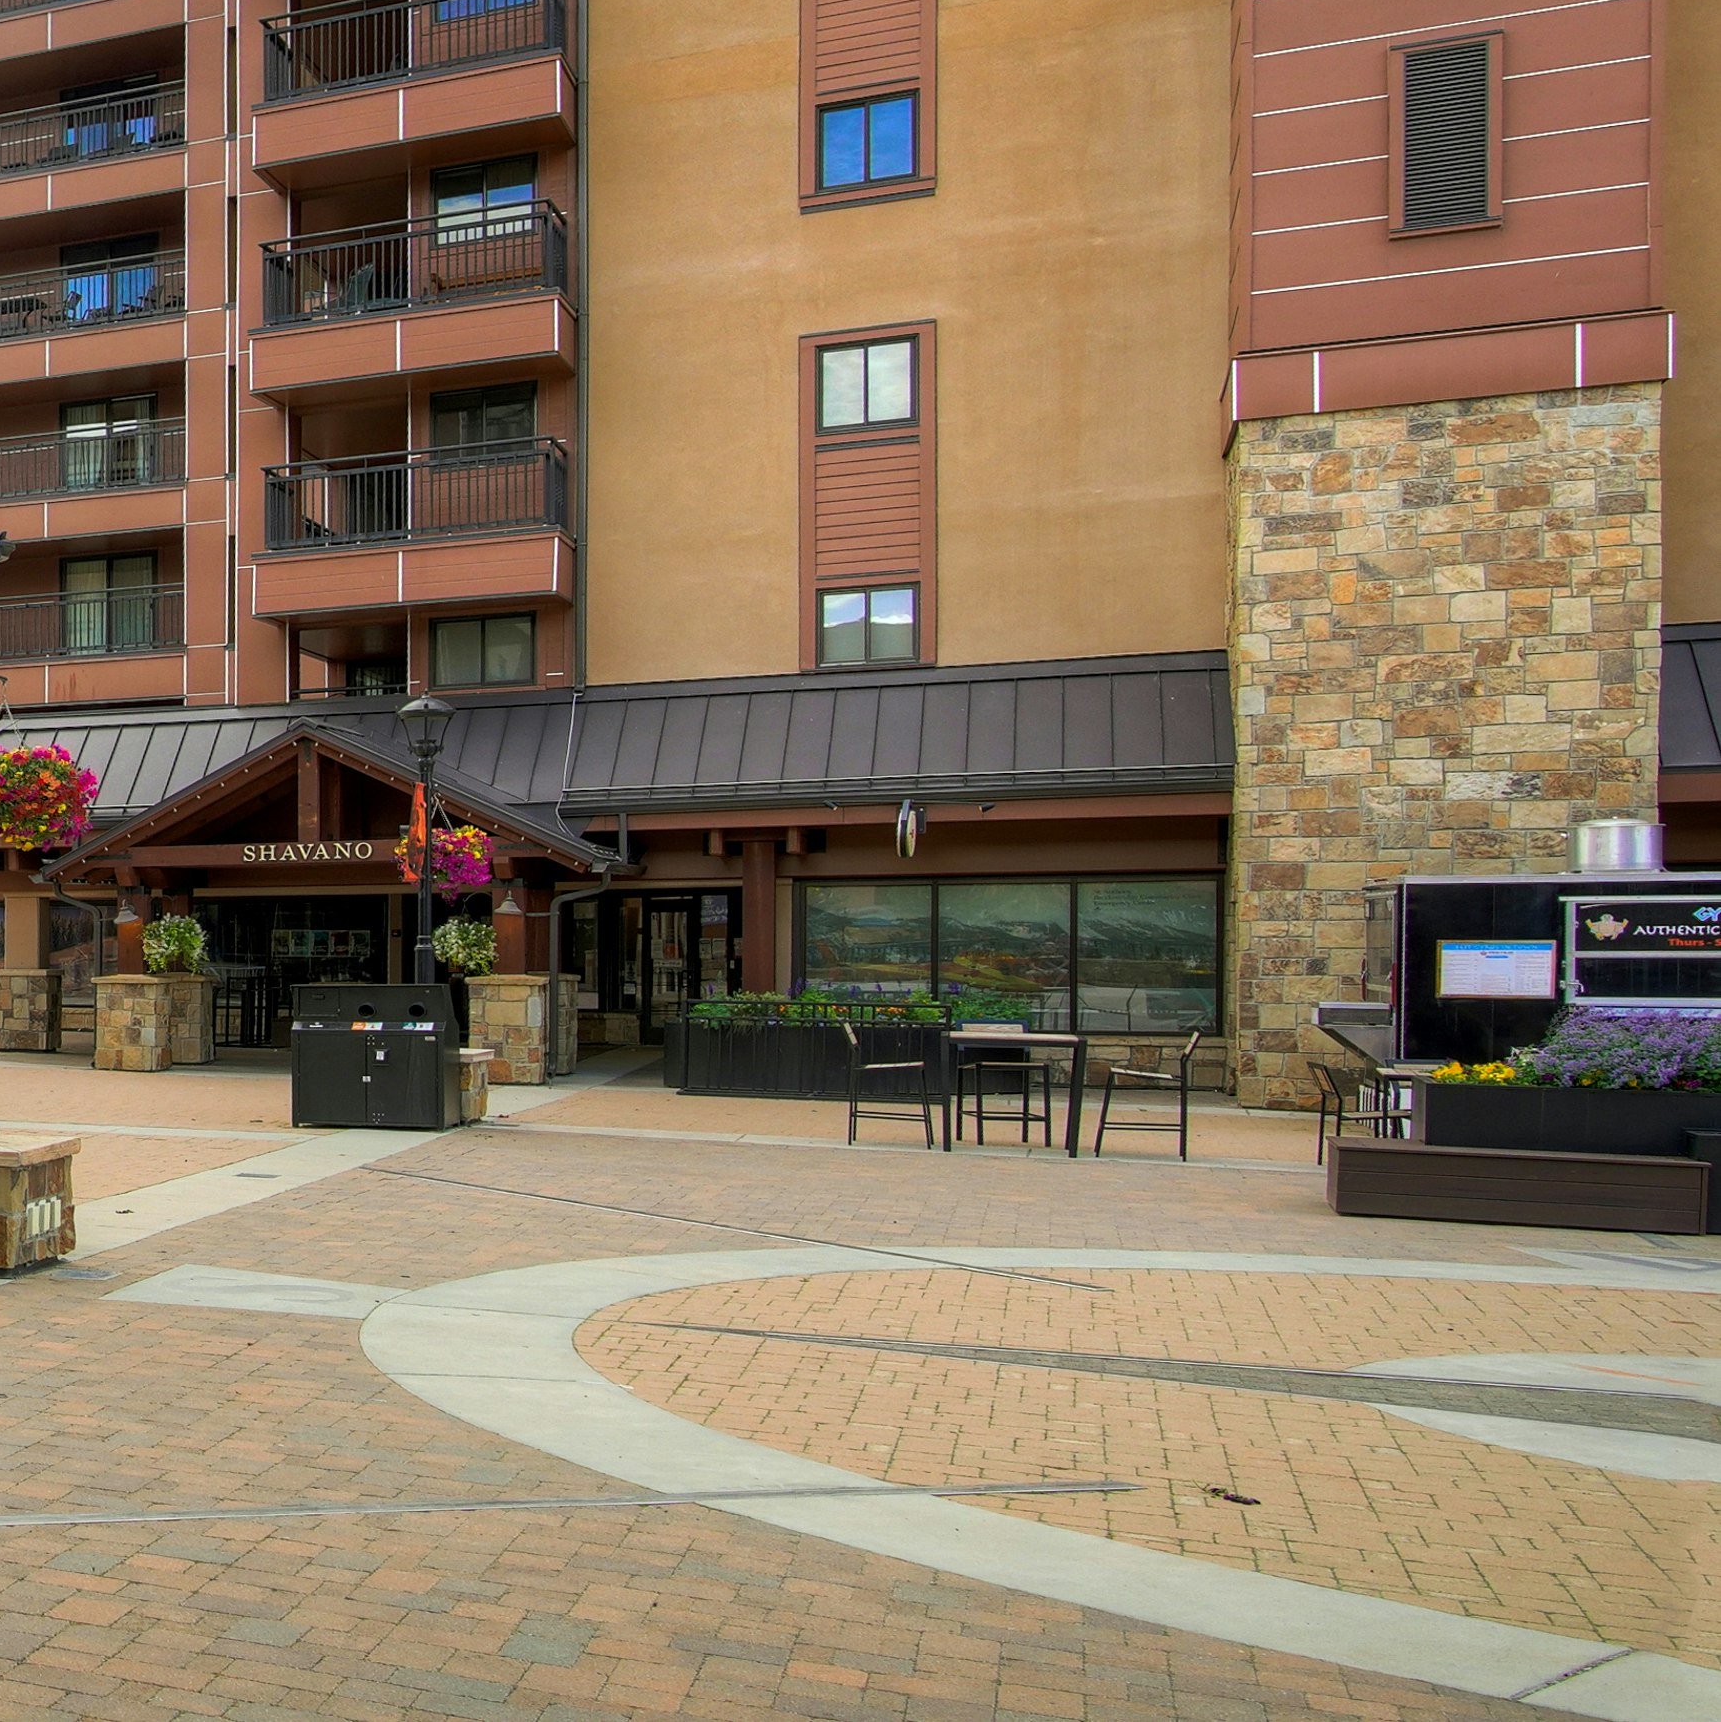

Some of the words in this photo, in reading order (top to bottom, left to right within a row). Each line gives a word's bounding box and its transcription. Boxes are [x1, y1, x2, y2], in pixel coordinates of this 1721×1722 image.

[242, 842, 373, 862] SHAVANO
[1633, 925, 1721, 936] AUTHENTIC
[1668, 938, 1705, 946] Thurs
